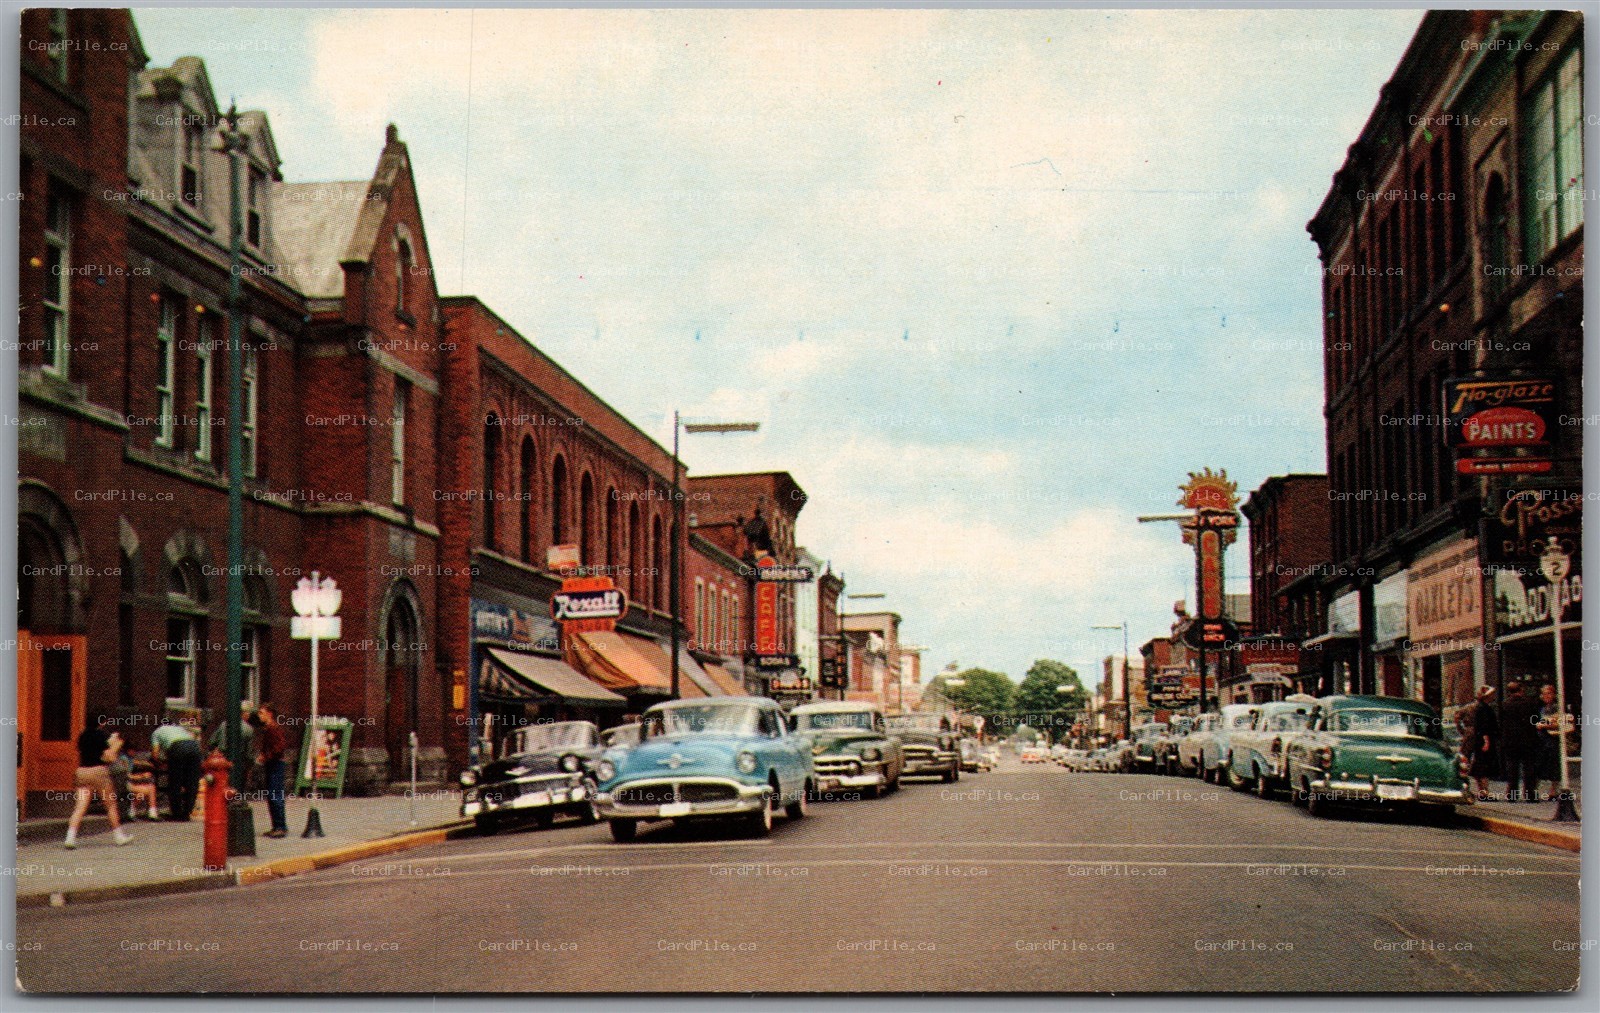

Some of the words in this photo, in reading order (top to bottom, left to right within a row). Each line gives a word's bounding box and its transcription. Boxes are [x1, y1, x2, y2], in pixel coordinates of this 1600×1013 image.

[1468, 421, 1537, 441] PAINTS
[1503, 538, 1577, 558] PHOO
[1550, 561, 1561, 577] 2
[554, 591, 620, 619] Rexall
